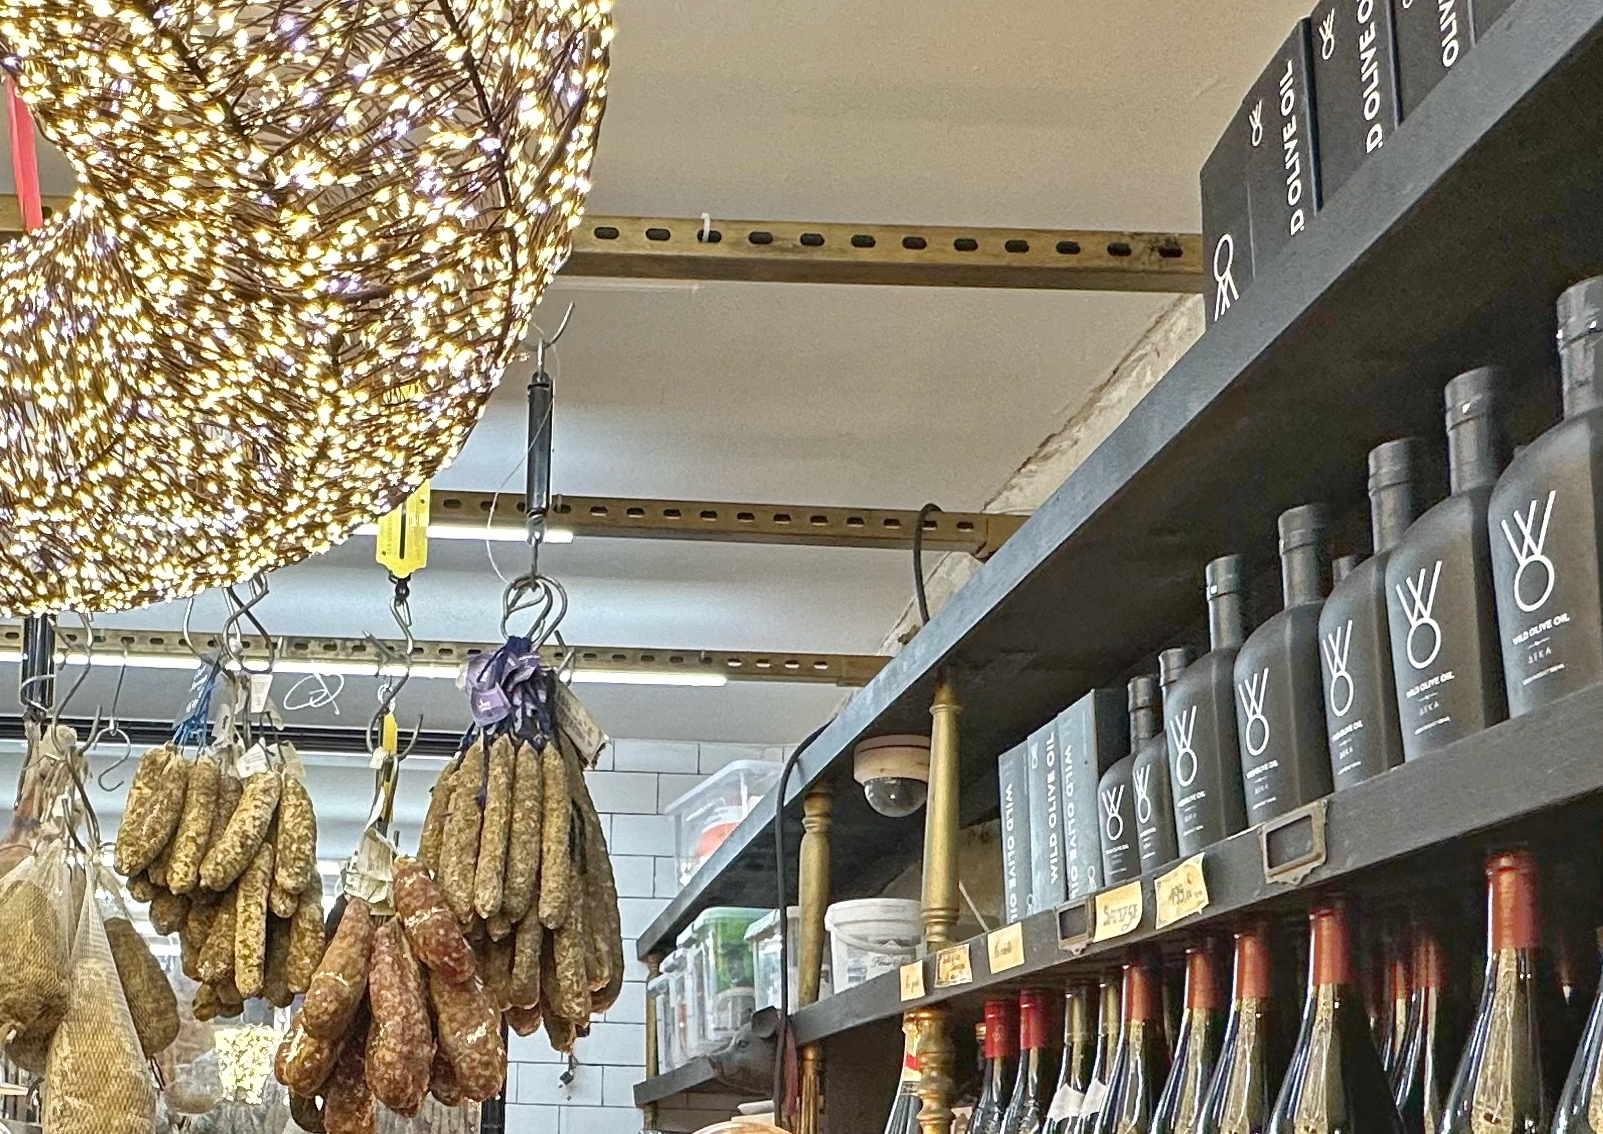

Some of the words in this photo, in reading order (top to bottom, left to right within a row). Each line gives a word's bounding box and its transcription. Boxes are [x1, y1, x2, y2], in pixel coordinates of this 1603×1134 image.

[1437, 0, 1459, 67] OLIV
[1279, 59, 1295, 116] OIL
[1359, 22, 1381, 120] OLIVE
[1283, 115, 1302, 206] OLIVE
[1046, 732, 1055, 766] OIL
[1064, 744, 1074, 798] WILD
[1005, 784, 1014, 832] WILD
[1047, 769, 1057, 829] OLIVE
[1049, 833, 1059, 885] WILD
[1066, 802, 1078, 861] OLIVE
[1006, 836, 1016, 889] OLIVE
[1070, 864, 1079, 899] OIL
